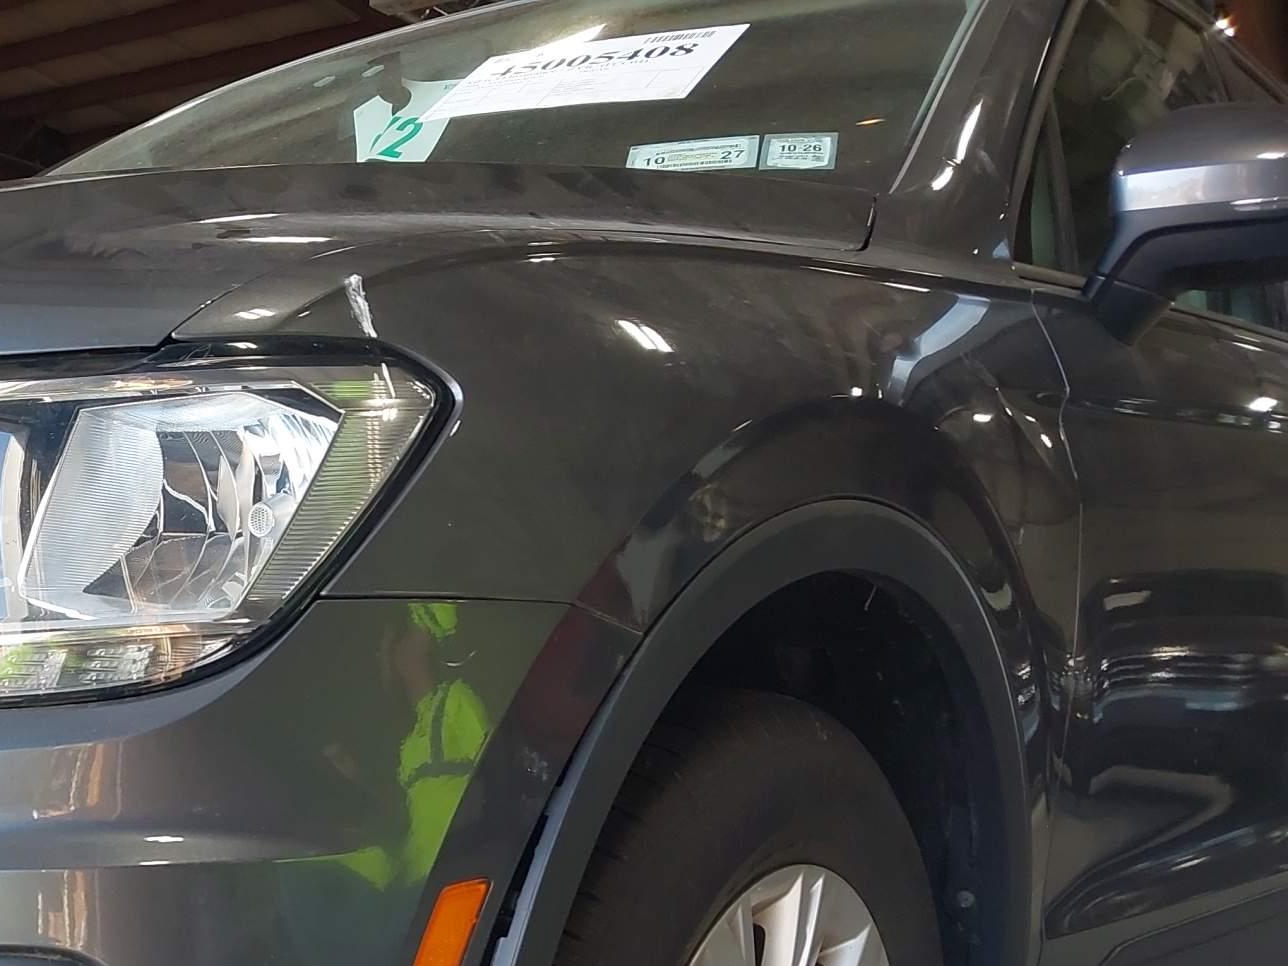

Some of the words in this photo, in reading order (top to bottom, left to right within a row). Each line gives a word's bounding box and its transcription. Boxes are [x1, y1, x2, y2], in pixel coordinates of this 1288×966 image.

[490, 42, 700, 78] 45005408
[779, 143, 797, 152] 10
[802, 143, 822, 152] 26
[643, 156, 665, 167] 10
[719, 149, 745, 160] 27
